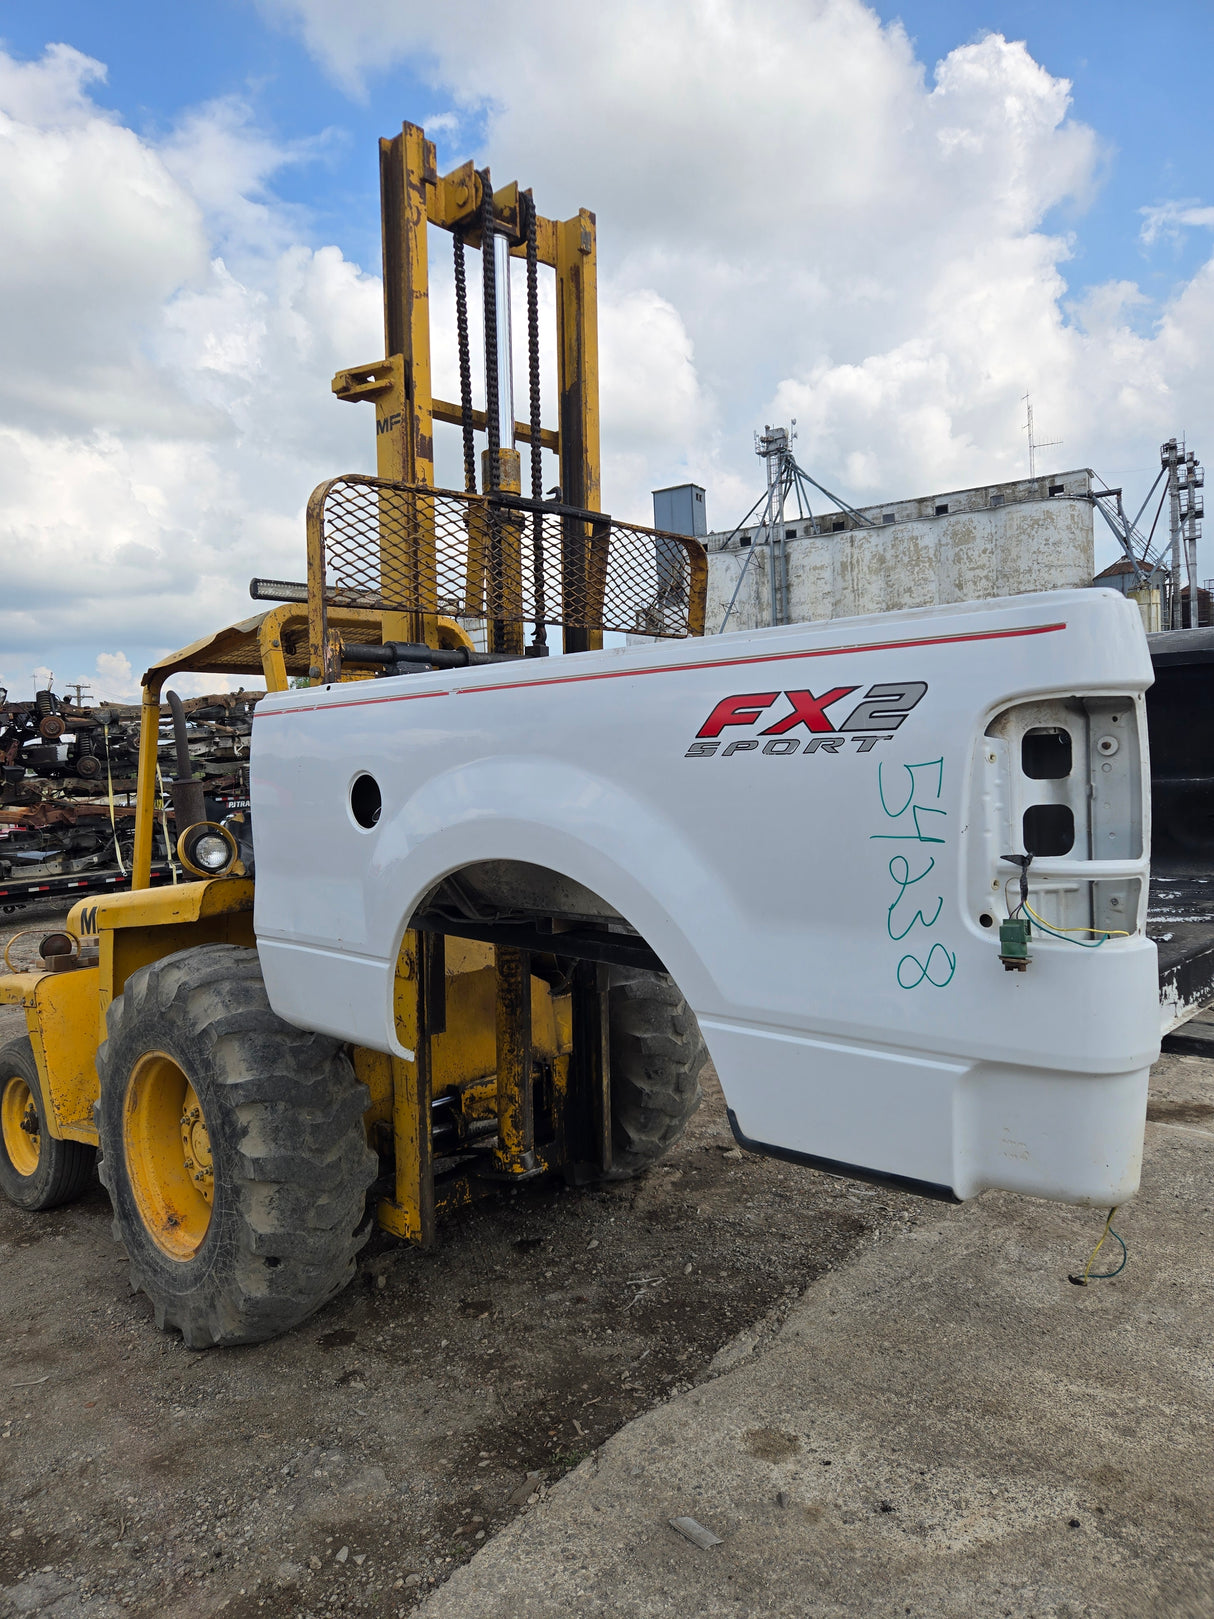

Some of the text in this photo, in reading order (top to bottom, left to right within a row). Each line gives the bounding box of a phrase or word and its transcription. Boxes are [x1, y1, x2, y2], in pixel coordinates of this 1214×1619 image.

[376, 413, 401, 435] MF
[695, 681, 929, 738] FX2
[684, 735, 894, 758] SPORT
[870, 757, 956, 989] 54238
[81, 906, 100, 935] M
